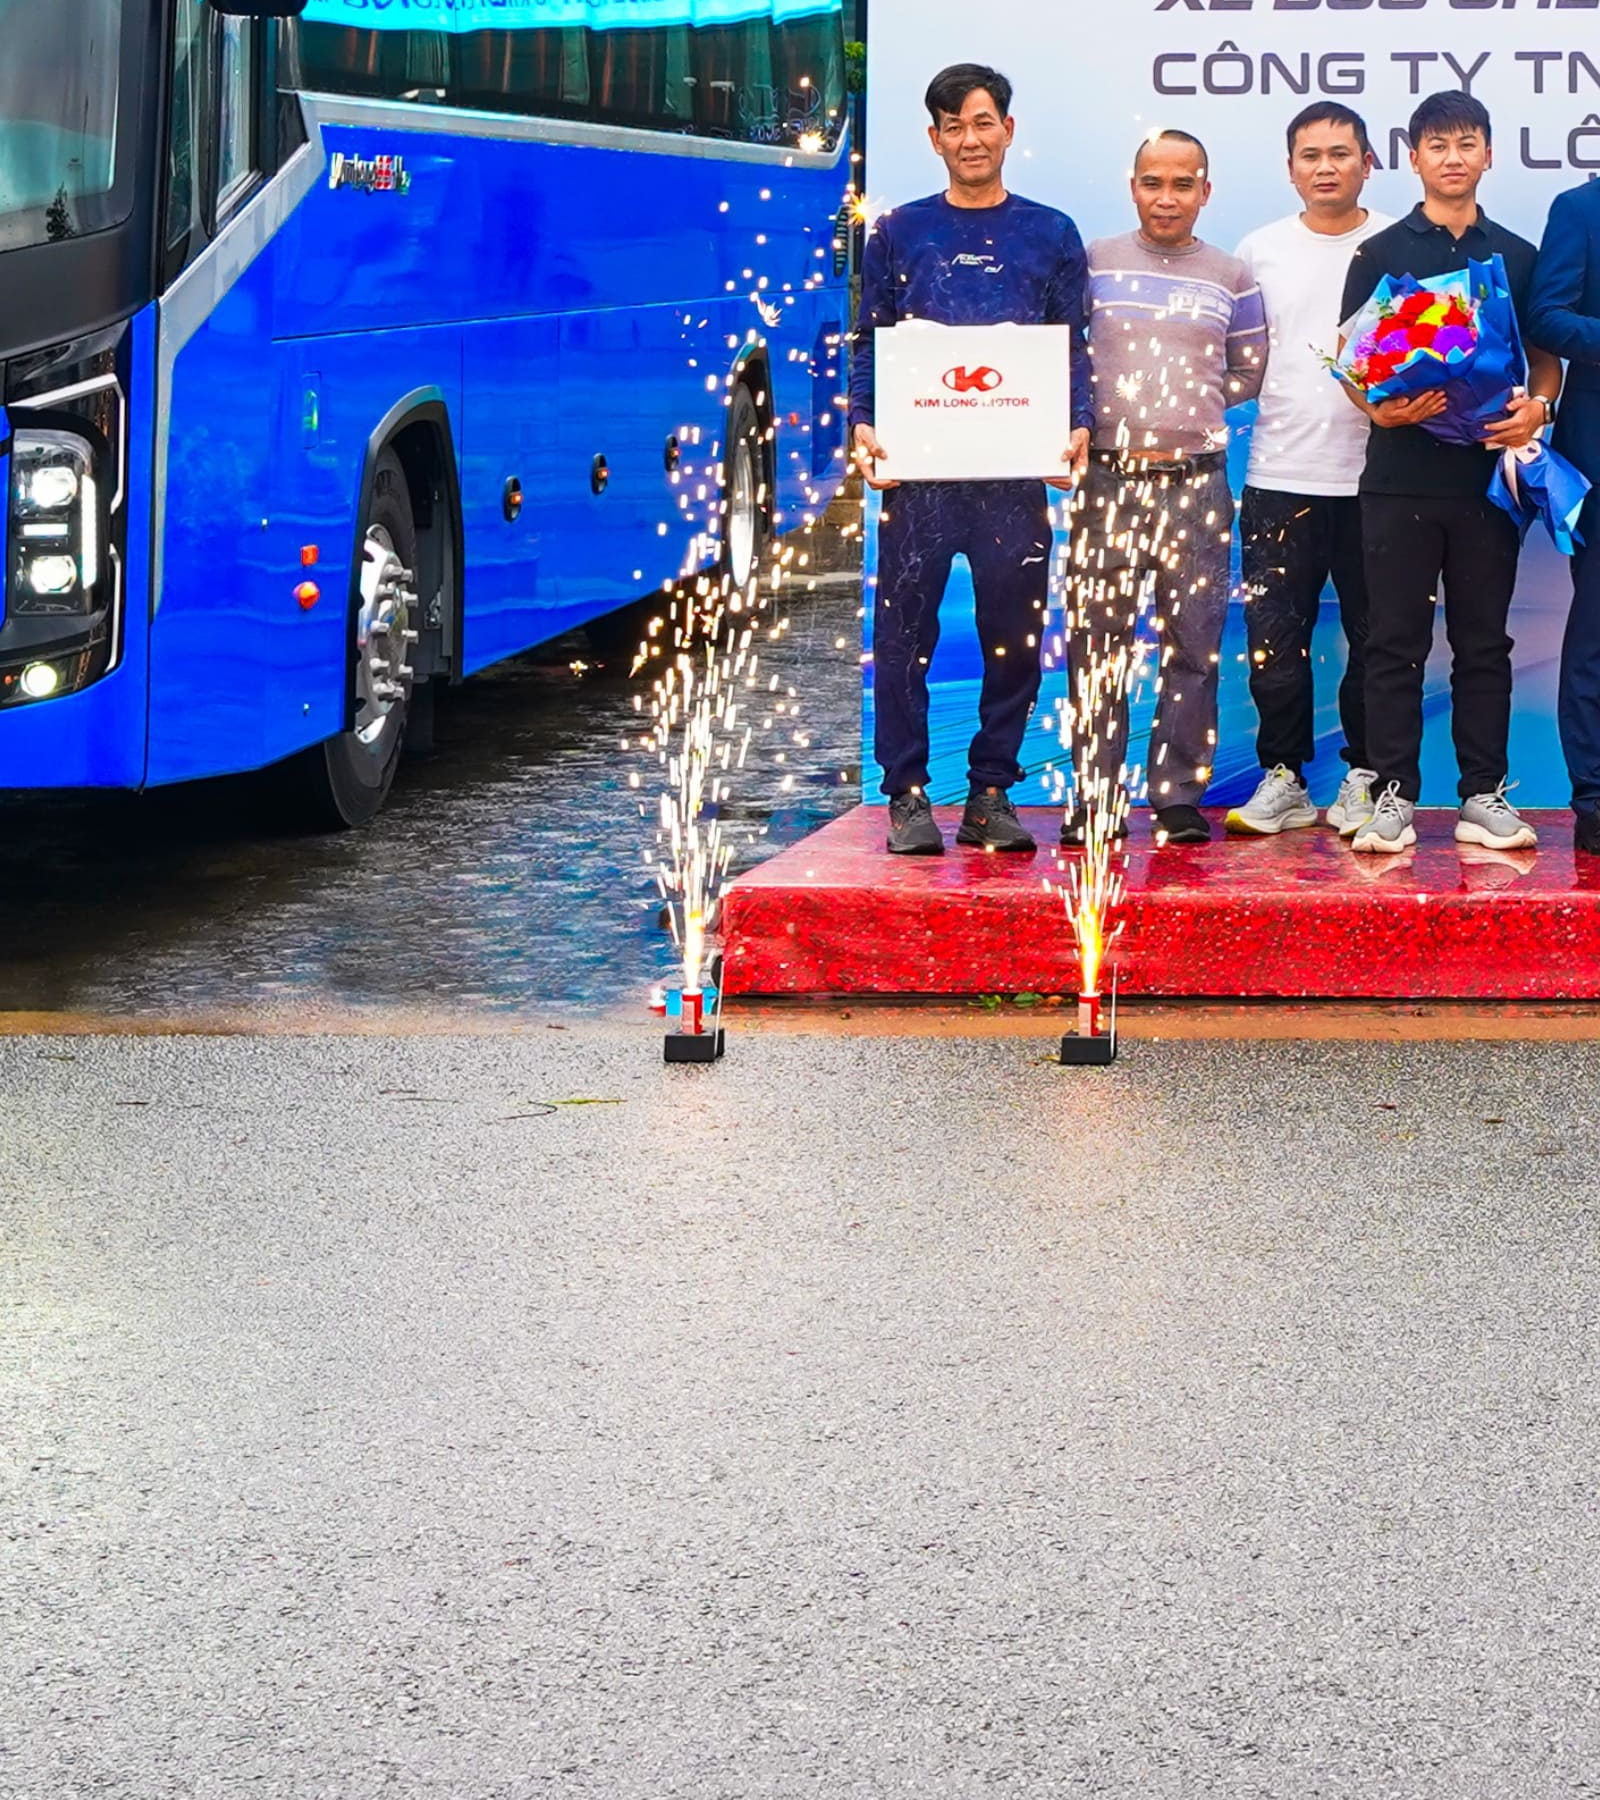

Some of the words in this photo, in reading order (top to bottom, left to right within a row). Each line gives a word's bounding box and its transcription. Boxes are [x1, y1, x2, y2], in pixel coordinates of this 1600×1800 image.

[1152, 40, 1366, 95] CÔNG
[1390, 50, 1492, 94] TY
[913, 397, 941, 408] KIM
[943, 398, 978, 408] LONG
